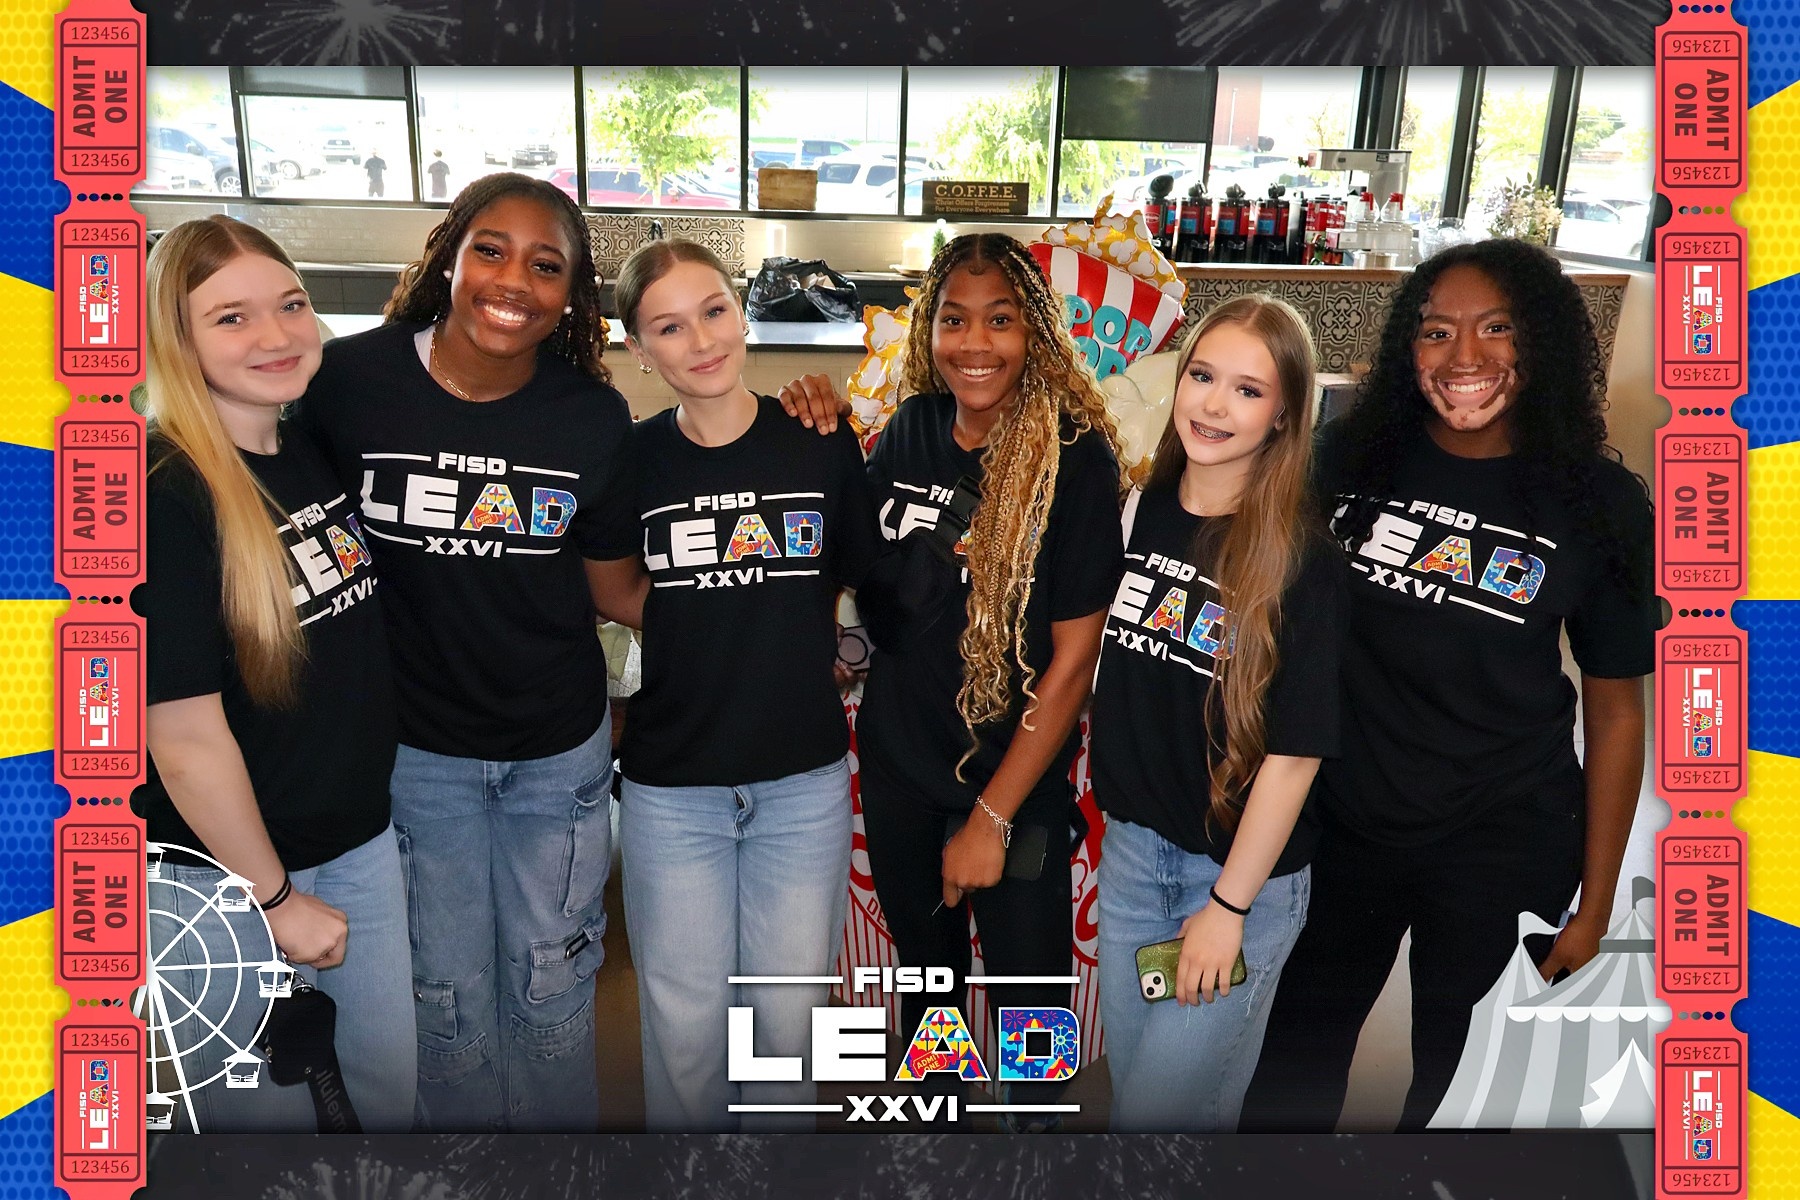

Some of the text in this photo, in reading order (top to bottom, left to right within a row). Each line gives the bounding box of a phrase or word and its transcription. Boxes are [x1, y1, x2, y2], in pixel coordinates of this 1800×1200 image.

[935, 184, 1017, 198] C.O.F.F.E.E.
[974, 200, 1010, 208] Forgiveness
[975, 206, 1010, 214] Everywhere
[1064, 294, 1153, 355] POP
[438, 452, 507, 476] FISD
[360, 470, 578, 537] LEAD
[694, 491, 757, 512] FISD
[929, 484, 955, 505] FIS
[289, 502, 327, 531] FISD
[1408, 500, 1477, 531] FISD
[424, 535, 503, 558] XXVI
[1329, 503, 1546, 604] EAD
[695, 567, 763, 590] XXVI
[1145, 552, 1197, 582] FISD
[331, 577, 373, 617] XXVI
[1367, 564, 1447, 604] XXVI
[1110, 571, 1239, 660] EAD
[1117, 626, 1168, 661] XXVI
